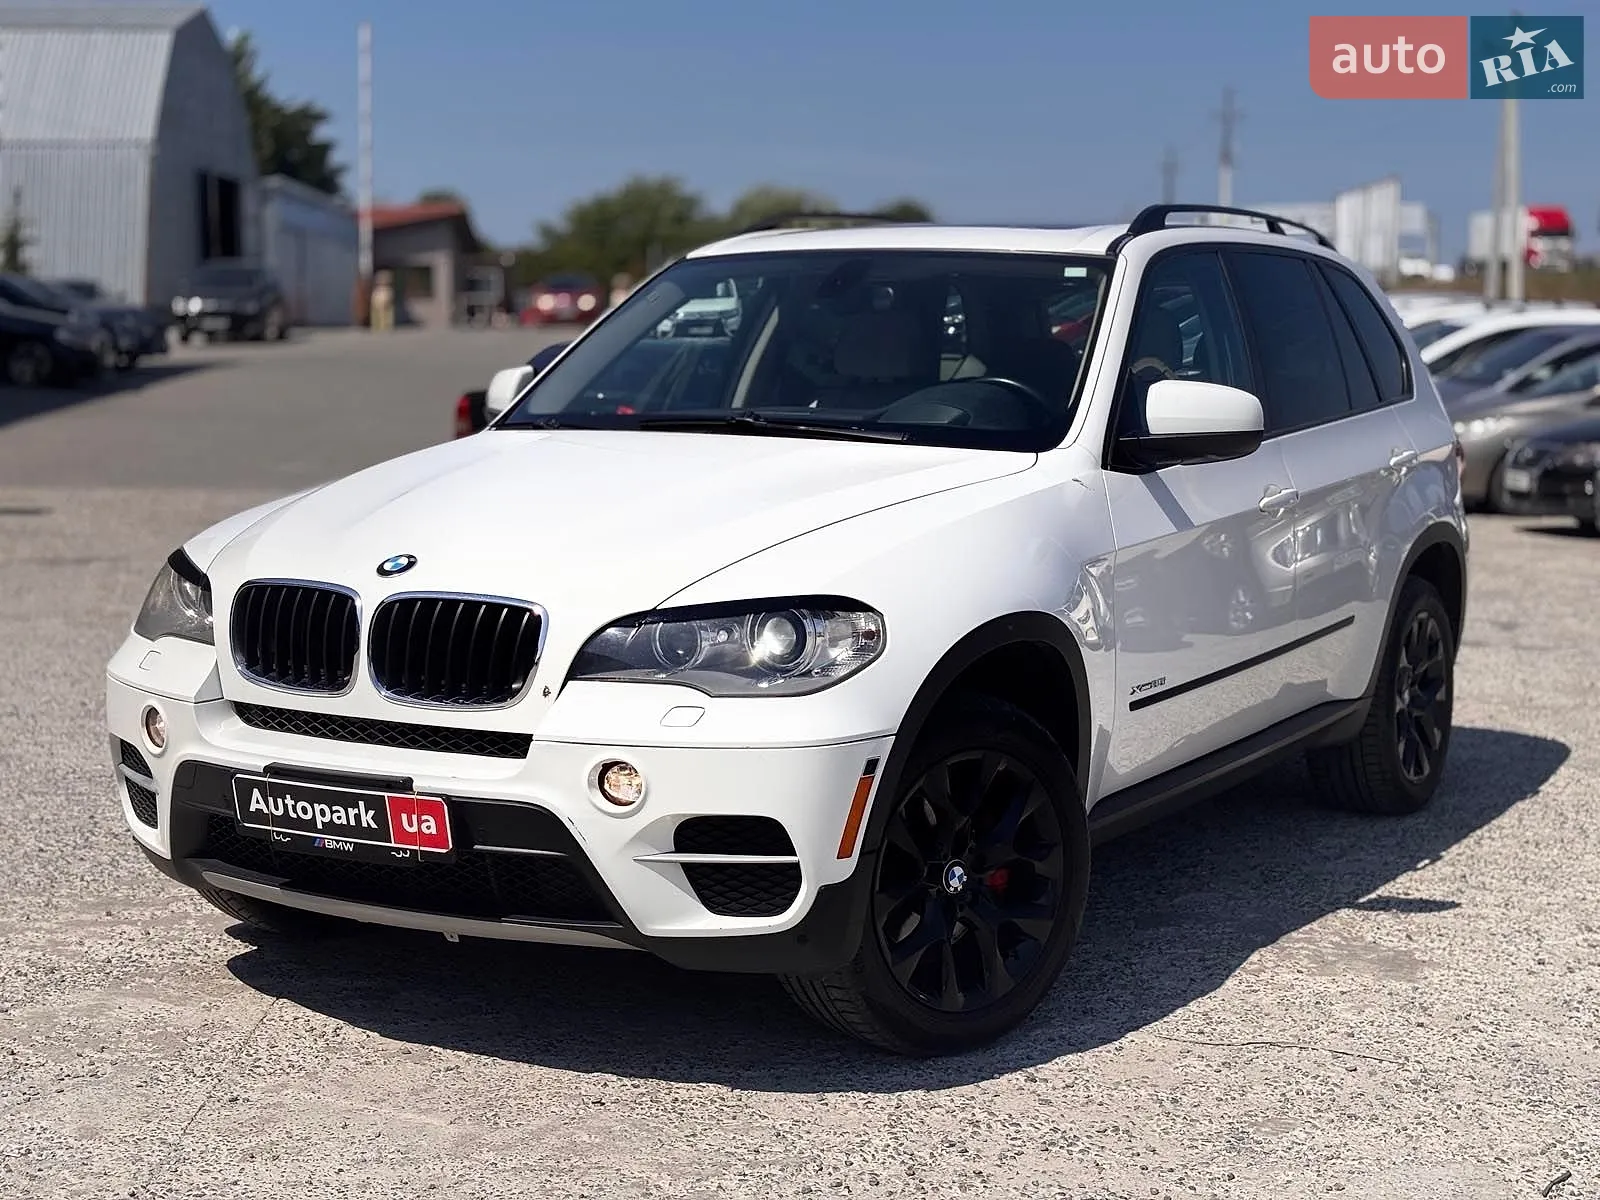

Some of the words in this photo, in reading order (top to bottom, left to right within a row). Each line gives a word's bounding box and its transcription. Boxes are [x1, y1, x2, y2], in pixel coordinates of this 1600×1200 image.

[249, 788, 378, 829] Autopark
[401, 813, 437, 835] ua
[325, 840, 354, 851] BMW
